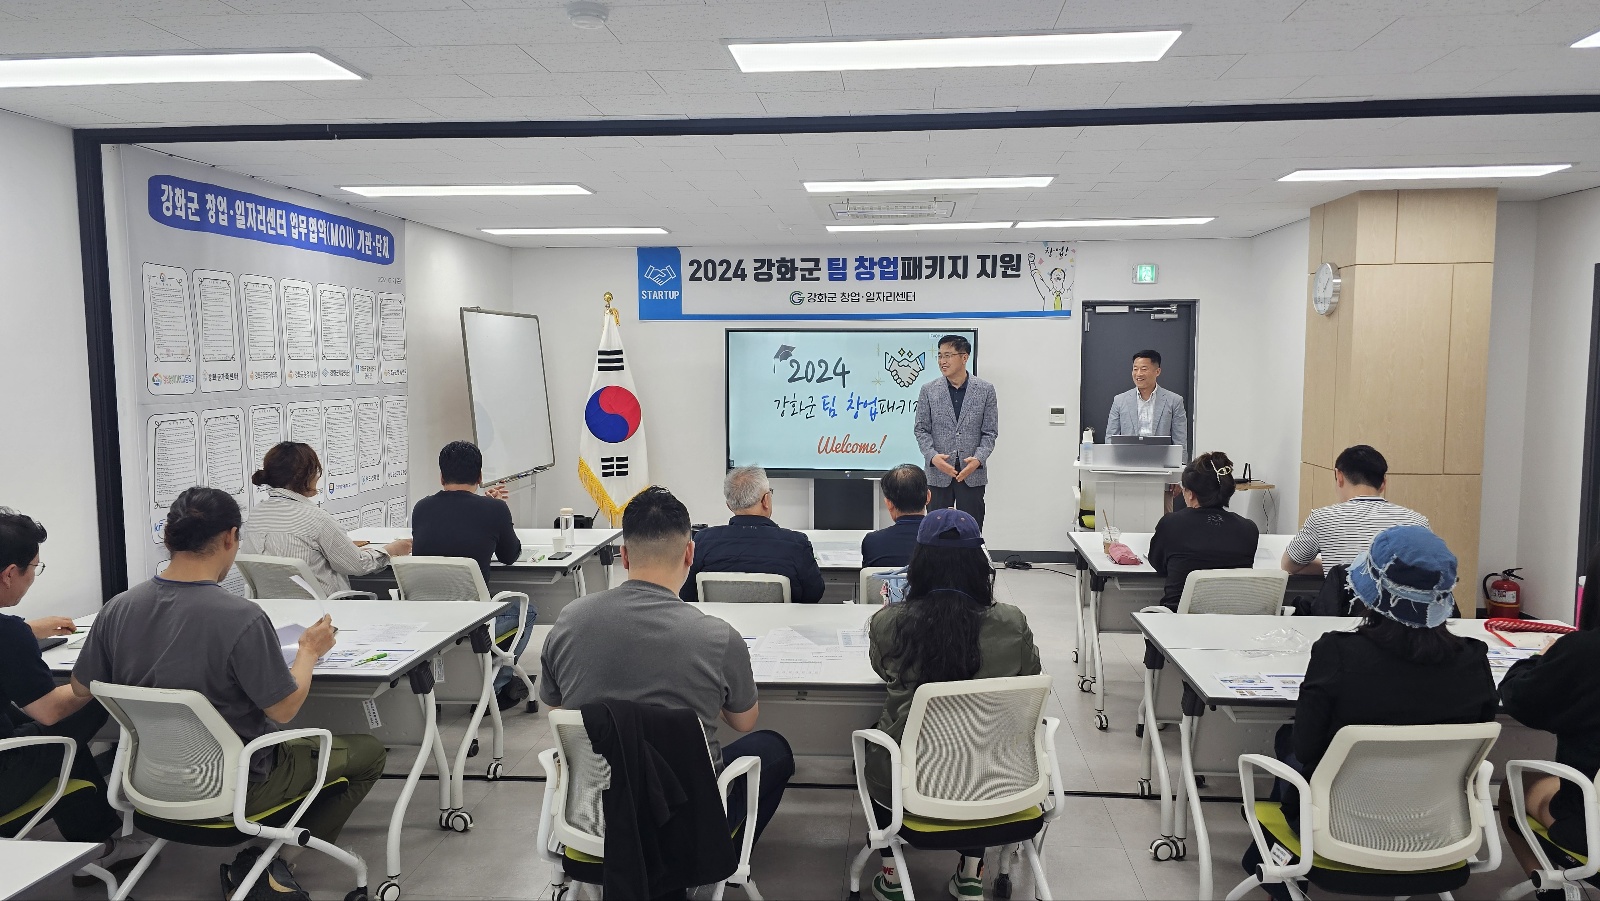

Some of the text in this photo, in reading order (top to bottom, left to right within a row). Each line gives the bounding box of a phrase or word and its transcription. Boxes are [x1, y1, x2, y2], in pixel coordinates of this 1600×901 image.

[160, 183, 390, 259] 강화군 창업·일자리센터 업무협약(MOU) 기관·단체
[688, 253, 1022, 283] 2024 강화군 팀 창업패키지 지원
[641, 290, 680, 300] STARTUP
[807, 291, 916, 303] 강화군 창업·일자리센터
[787, 356, 851, 389] 2024
[773, 393, 817, 419] 강화군
[821, 395, 838, 418] 팀
[817, 433, 888, 454] Welcome!
